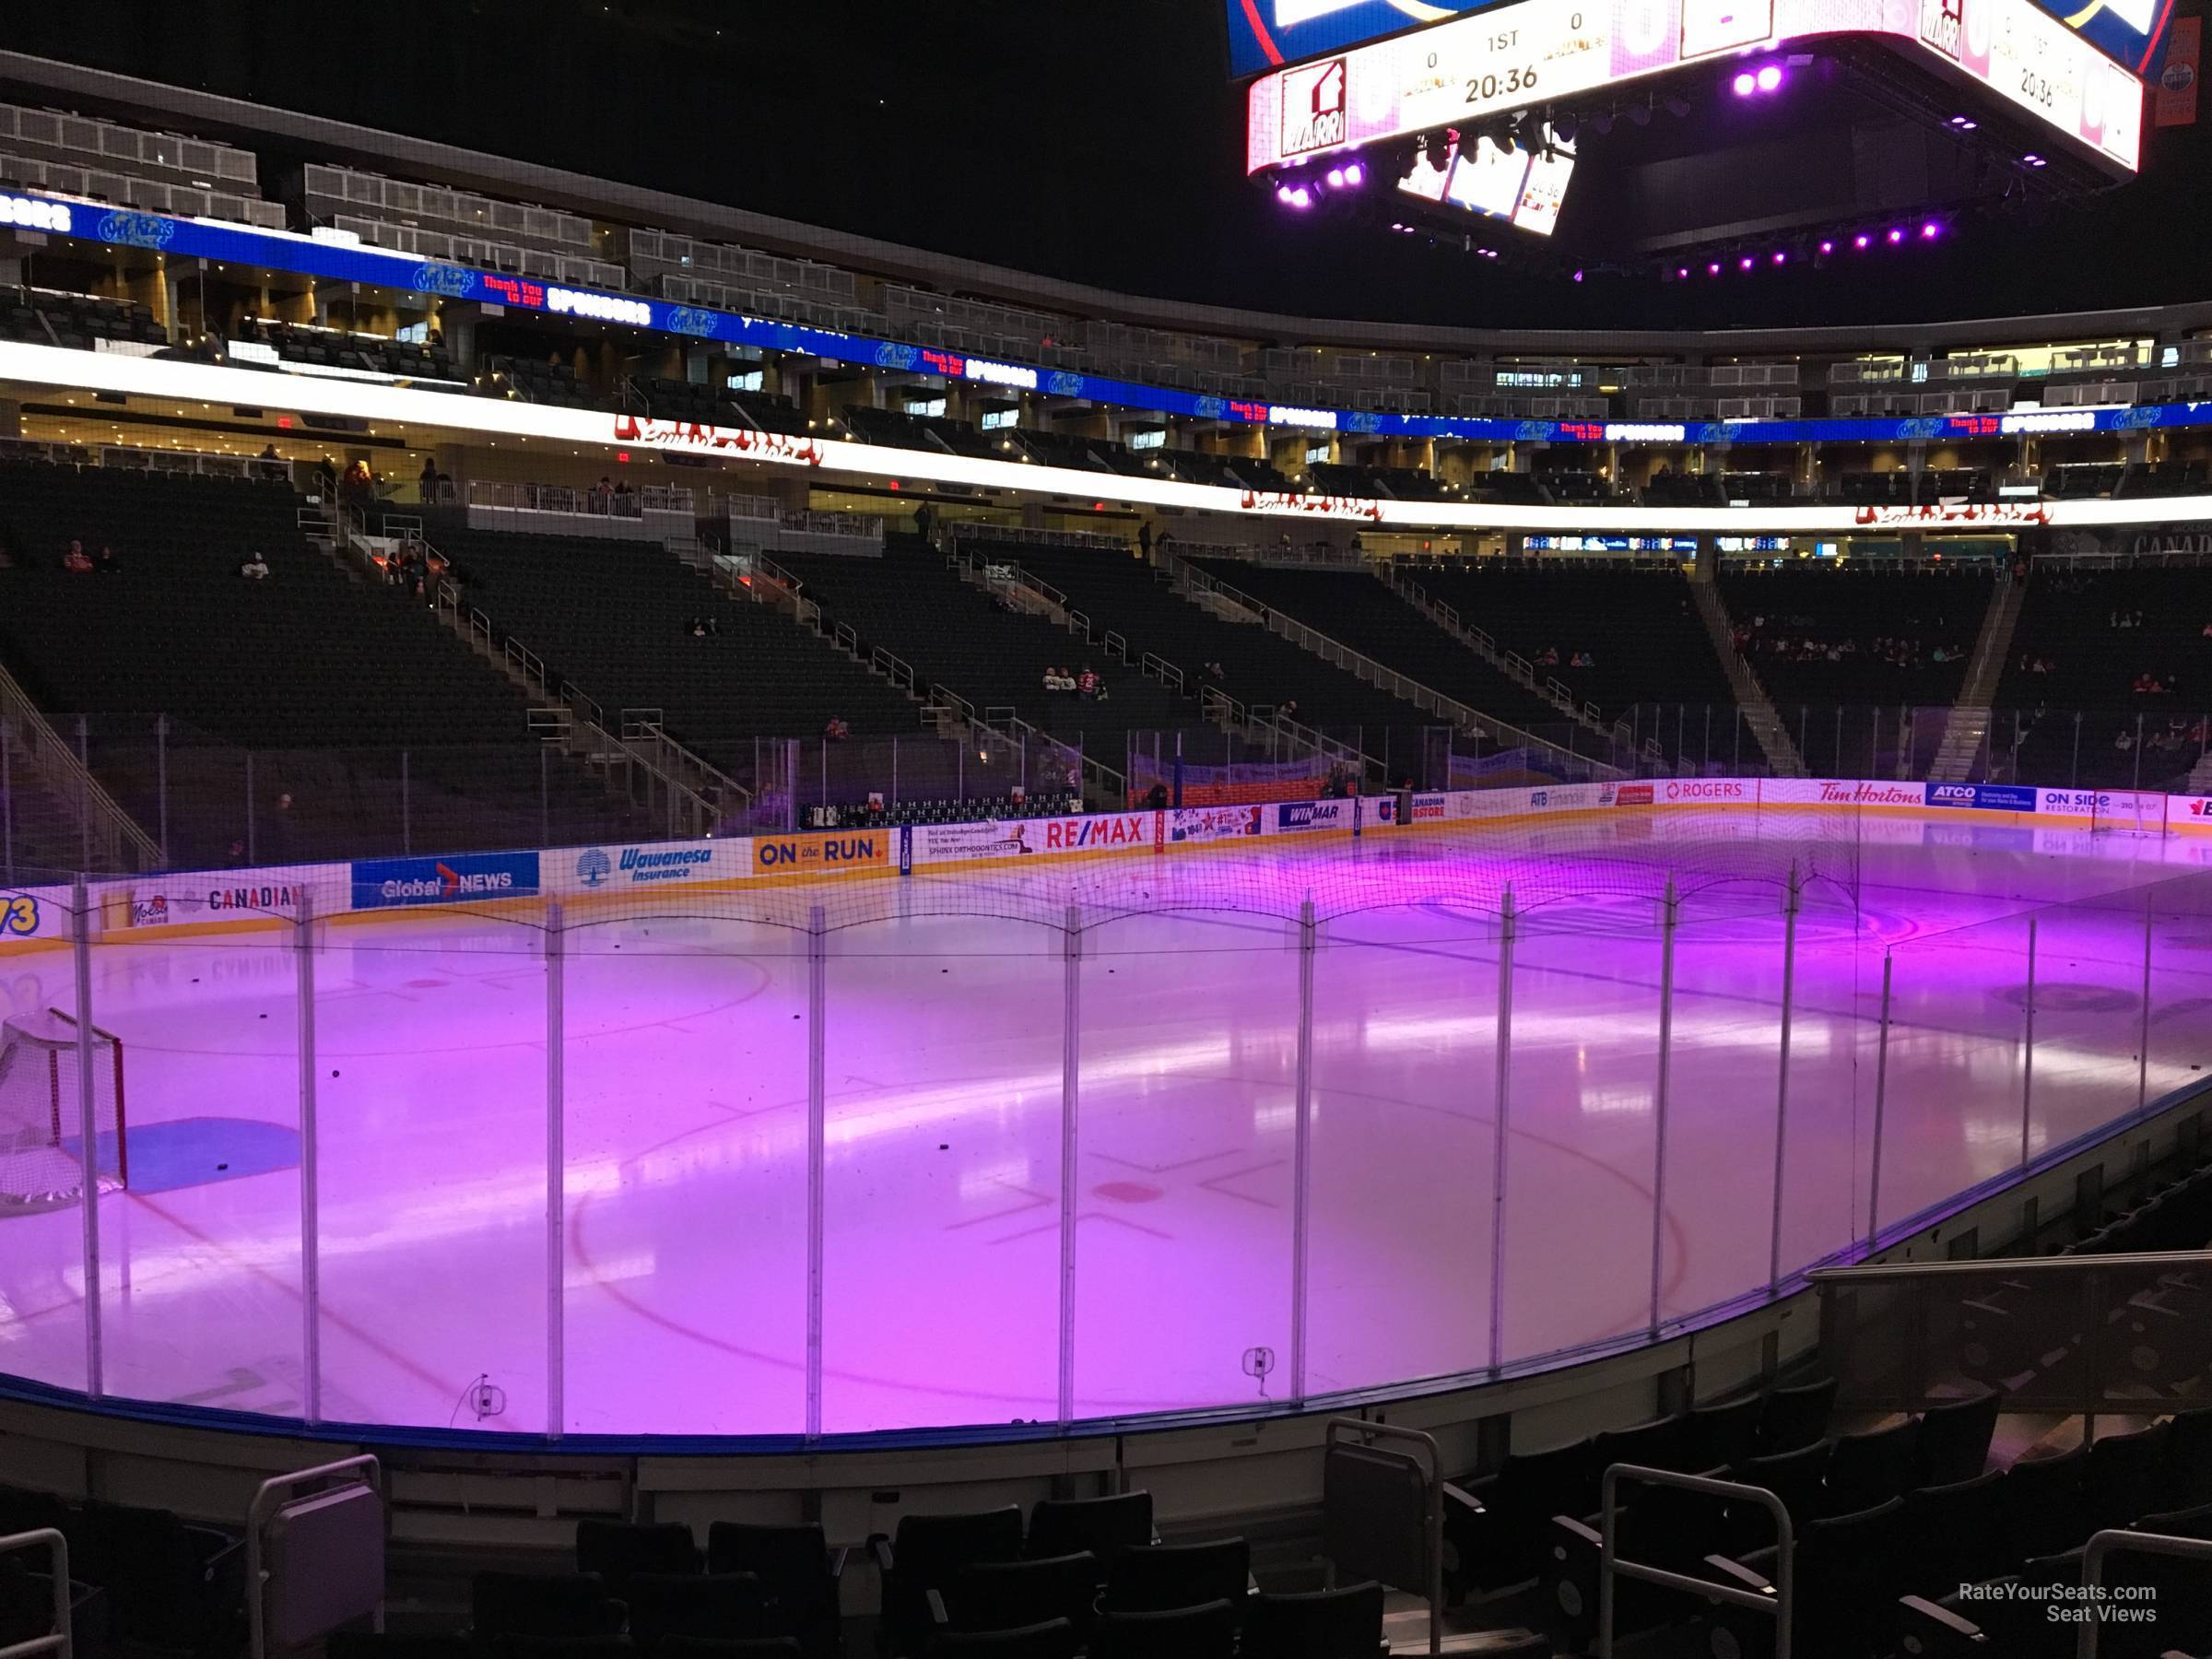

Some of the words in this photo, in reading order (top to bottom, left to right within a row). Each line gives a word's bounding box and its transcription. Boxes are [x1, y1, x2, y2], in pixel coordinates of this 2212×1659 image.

[1571, 13, 1583, 30] 0
[1487, 29, 1520, 53] 1ST
[1427, 53, 1438, 69] 0
[1465, 64, 1538, 103] 20:36
[2021, 67, 2053, 108] 20:36
[484, 275, 518, 292] Thank
[522, 282, 543, 297] You
[508, 291, 521, 303] to
[523, 295, 544, 307] our
[547, 287, 651, 325] SPONSORS
[923, 350, 947, 364] Thank
[947, 356, 963, 368] You
[965, 358, 1038, 389] SPONSORS
[1950, 418, 1979, 429] Thank
[1981, 417, 1999, 427] You
[1531, 791, 1548, 806] ATB
[1682, 782, 1742, 797] ROGERS
[1820, 782, 1852, 801] Tim
[1851, 783, 1923, 805] Hortons
[1933, 785, 1976, 799] ATCO
[2045, 793, 2070, 805] ON
[1289, 806, 1339, 822] WINMAR
[1047, 818, 1143, 848] RE/MAX
[619, 848, 712, 871] Wawanesa
[759, 842, 796, 865] ON
[802, 845, 818, 858] the
[824, 839, 874, 861] RUN
[929, 846, 953, 855] SPHINX
[631, 866, 690, 882] Insurance
[382, 877, 441, 899] Global
[459, 873, 512, 893] NEWS
